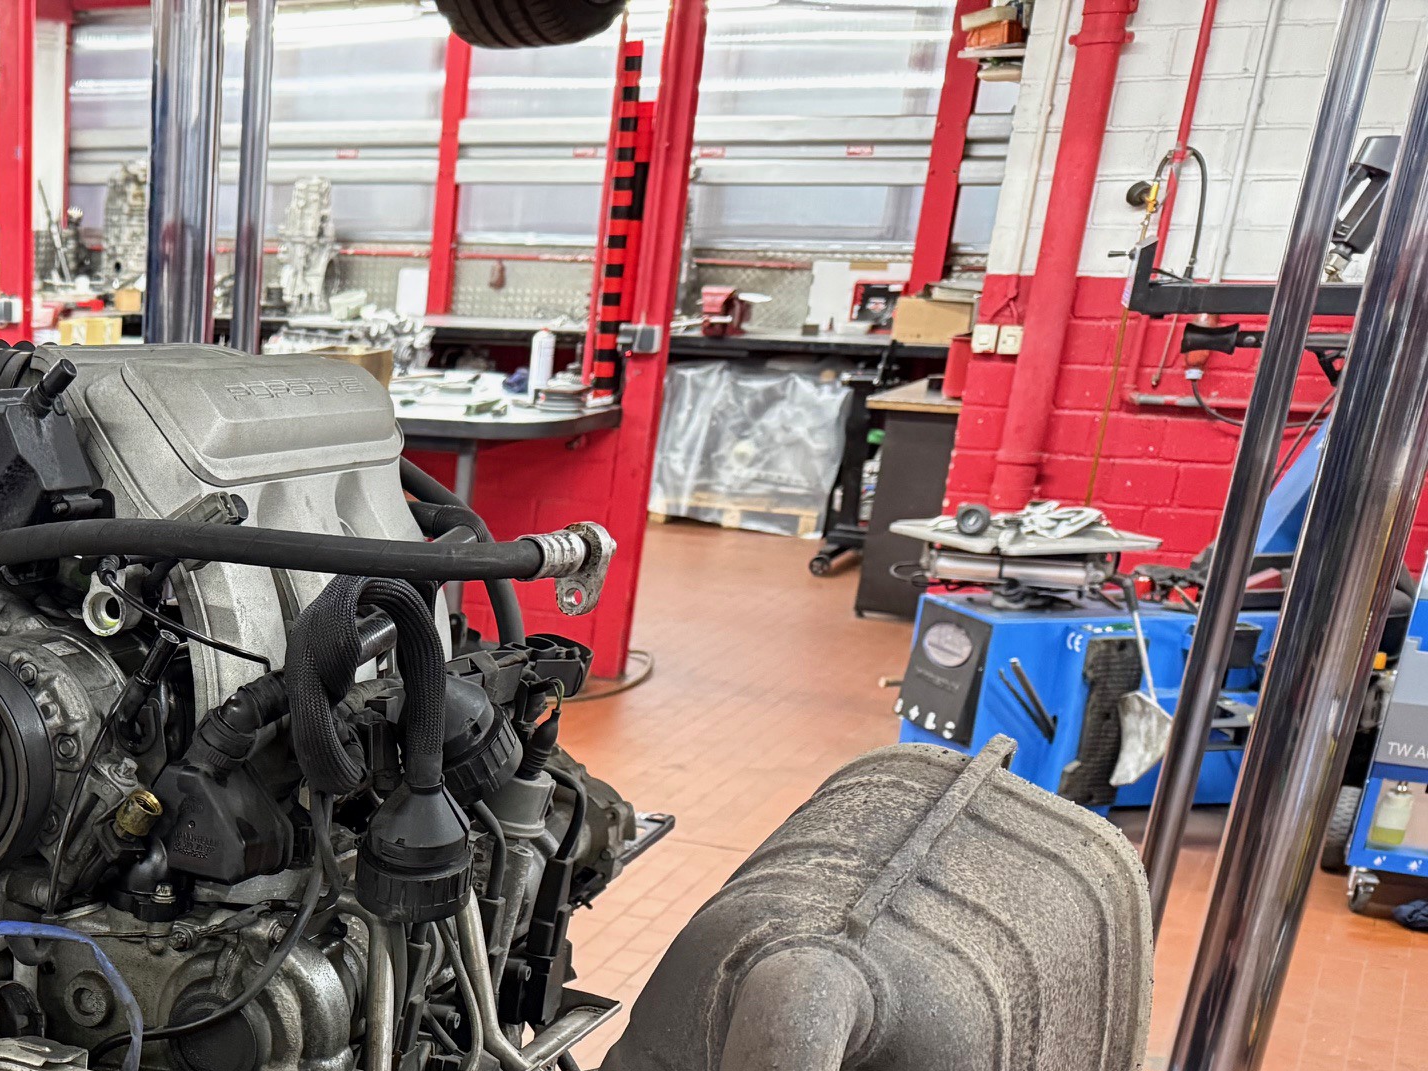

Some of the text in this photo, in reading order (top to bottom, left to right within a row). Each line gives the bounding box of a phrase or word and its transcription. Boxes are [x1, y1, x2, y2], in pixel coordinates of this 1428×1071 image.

[224, 376, 369, 401] PORSCHE
[1388, 741, 1428, 760] TW A
